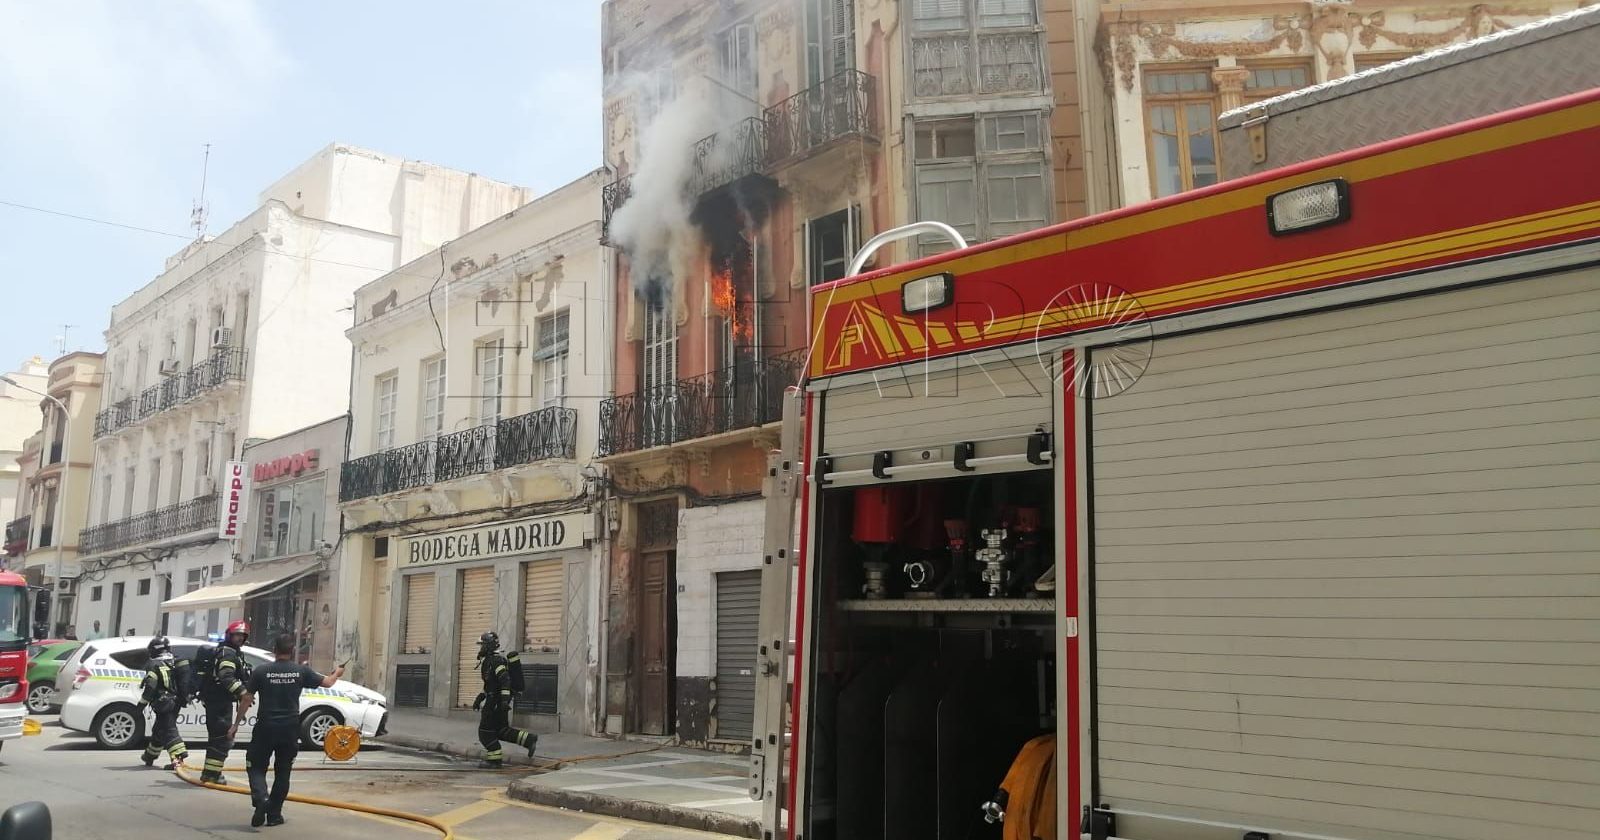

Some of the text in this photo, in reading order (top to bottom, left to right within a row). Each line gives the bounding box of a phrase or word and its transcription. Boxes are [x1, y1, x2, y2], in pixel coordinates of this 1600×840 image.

[409, 520, 565, 563] BODEGA MADRID
[175, 713, 207, 725] OLIC
